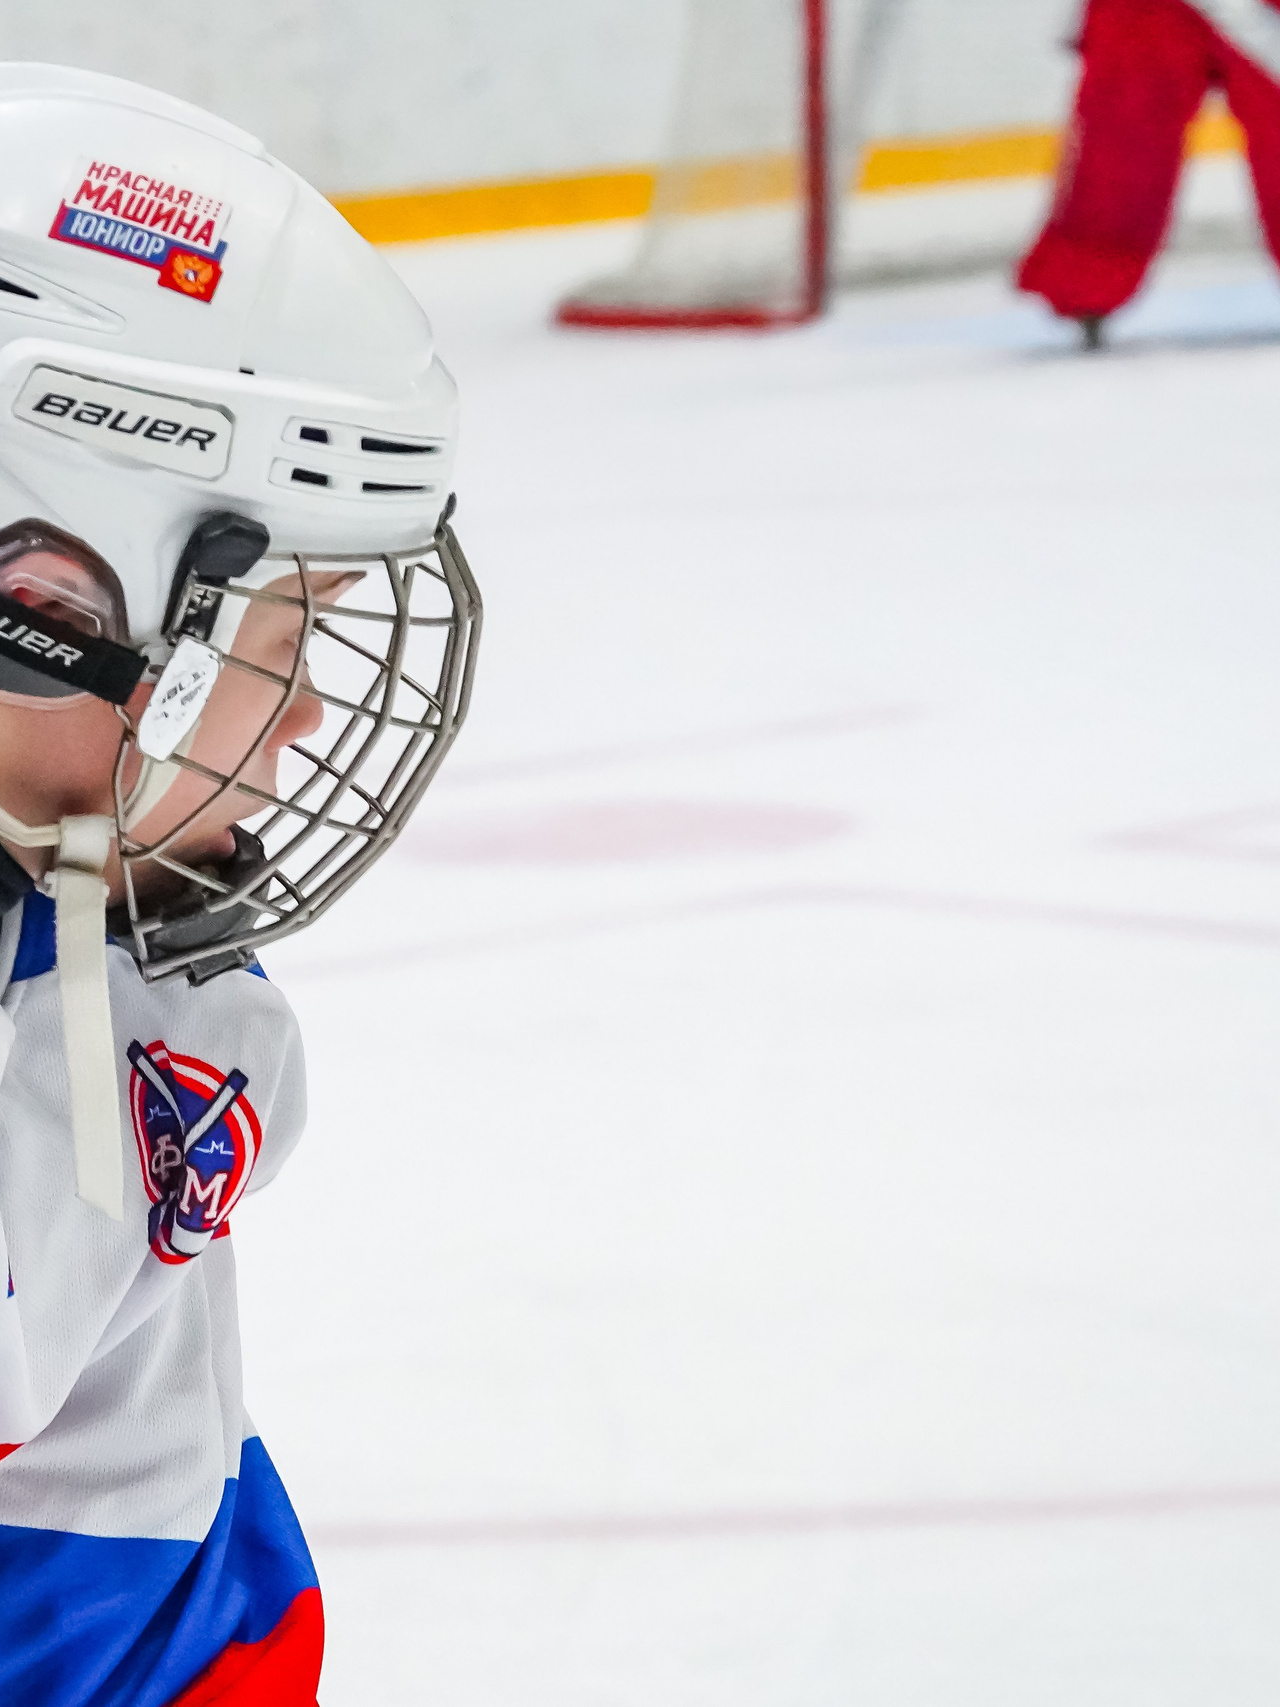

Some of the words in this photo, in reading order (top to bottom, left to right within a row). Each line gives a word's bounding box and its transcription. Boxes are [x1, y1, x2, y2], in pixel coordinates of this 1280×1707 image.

[70, 212, 166, 258] ЮНИОР
[73, 179, 216, 247] МАШИНА
[32, 392, 218, 452] BAUER
